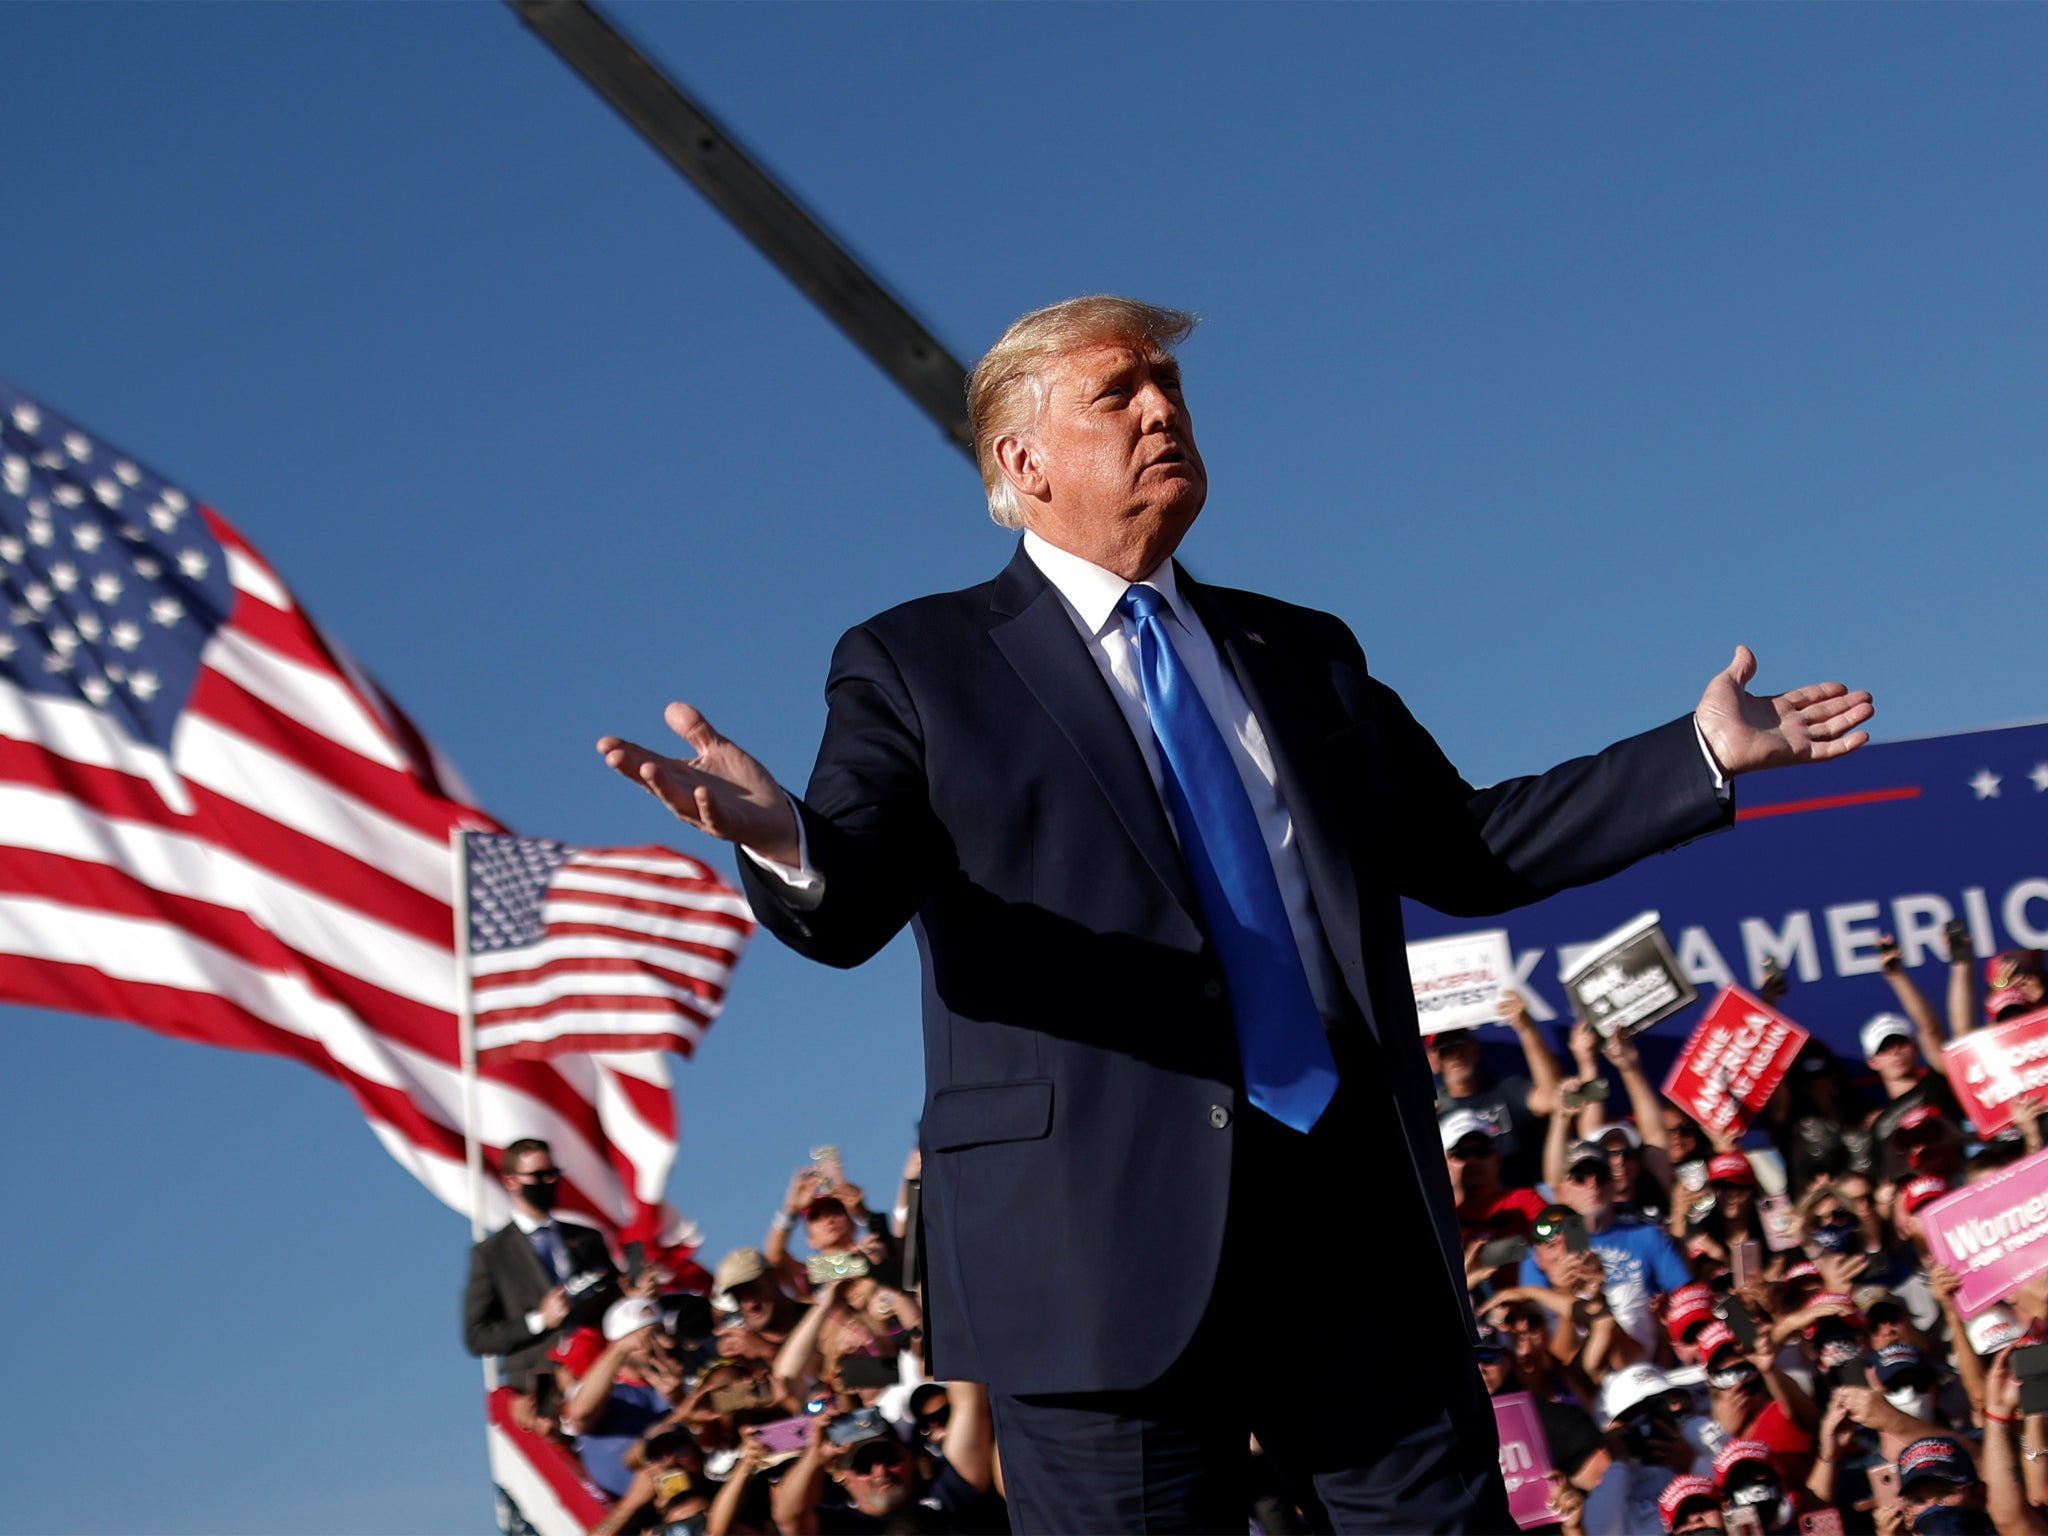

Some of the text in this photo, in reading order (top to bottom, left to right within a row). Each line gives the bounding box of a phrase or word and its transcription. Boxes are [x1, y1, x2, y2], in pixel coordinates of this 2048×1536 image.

[1689, 1025, 1733, 1078] MAKE
[1745, 1023, 1792, 1080] AGAIN
[1943, 1189, 2048, 1261] Wome
